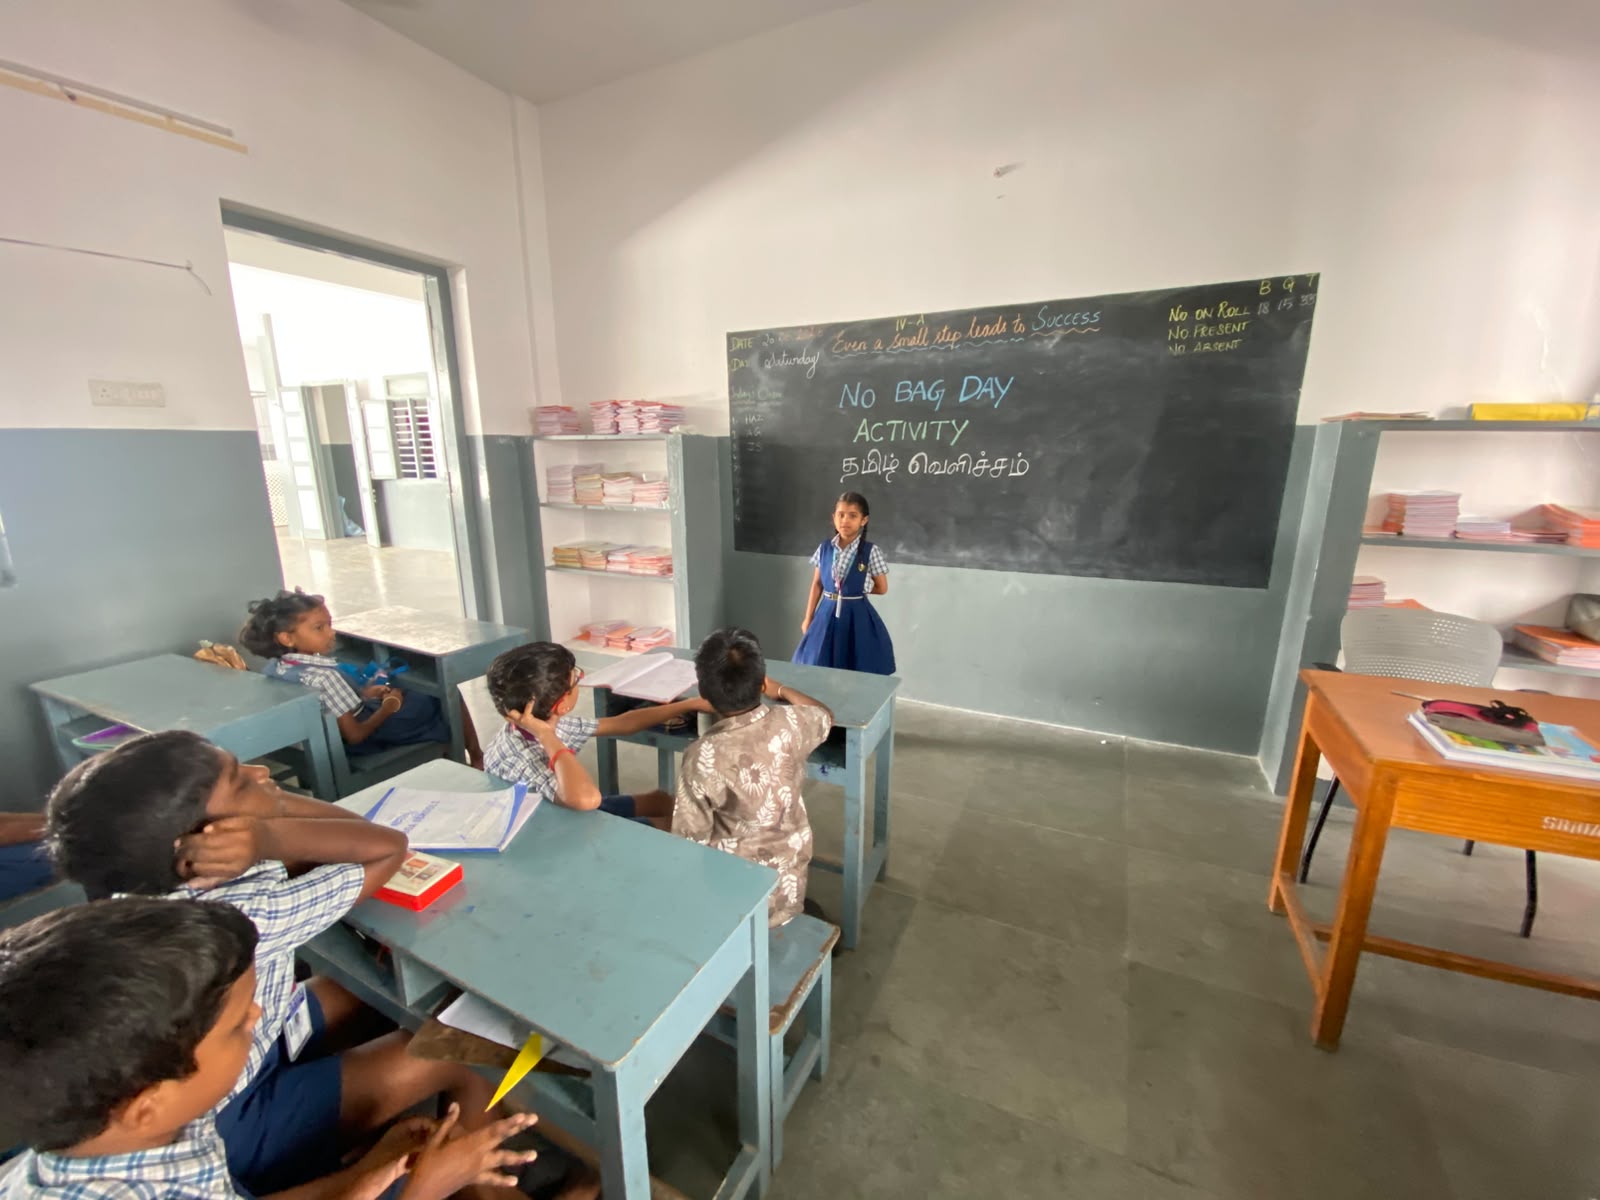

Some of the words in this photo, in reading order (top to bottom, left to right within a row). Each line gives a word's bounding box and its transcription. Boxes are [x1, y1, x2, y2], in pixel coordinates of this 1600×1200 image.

[1259, 280, 1272, 296] B
[831, 332, 868, 354] Even
[873, 341, 884, 350] a
[932, 328, 962, 350] step
[967, 316, 1009, 340] leads
[1012, 313, 1027, 335] to
[1193, 320, 1249, 337] PRESENT
[729, 336, 753, 352] DATE
[1193, 338, 1243, 353] ABSENT
[895, 379, 946, 411] BAG
[959, 375, 1015, 409] DAY
[852, 418, 970, 447] ACTIVITY
[839, 448, 900, 484] தமிழ்
[907, 450, 1030, 479] வெளிச்சம்
